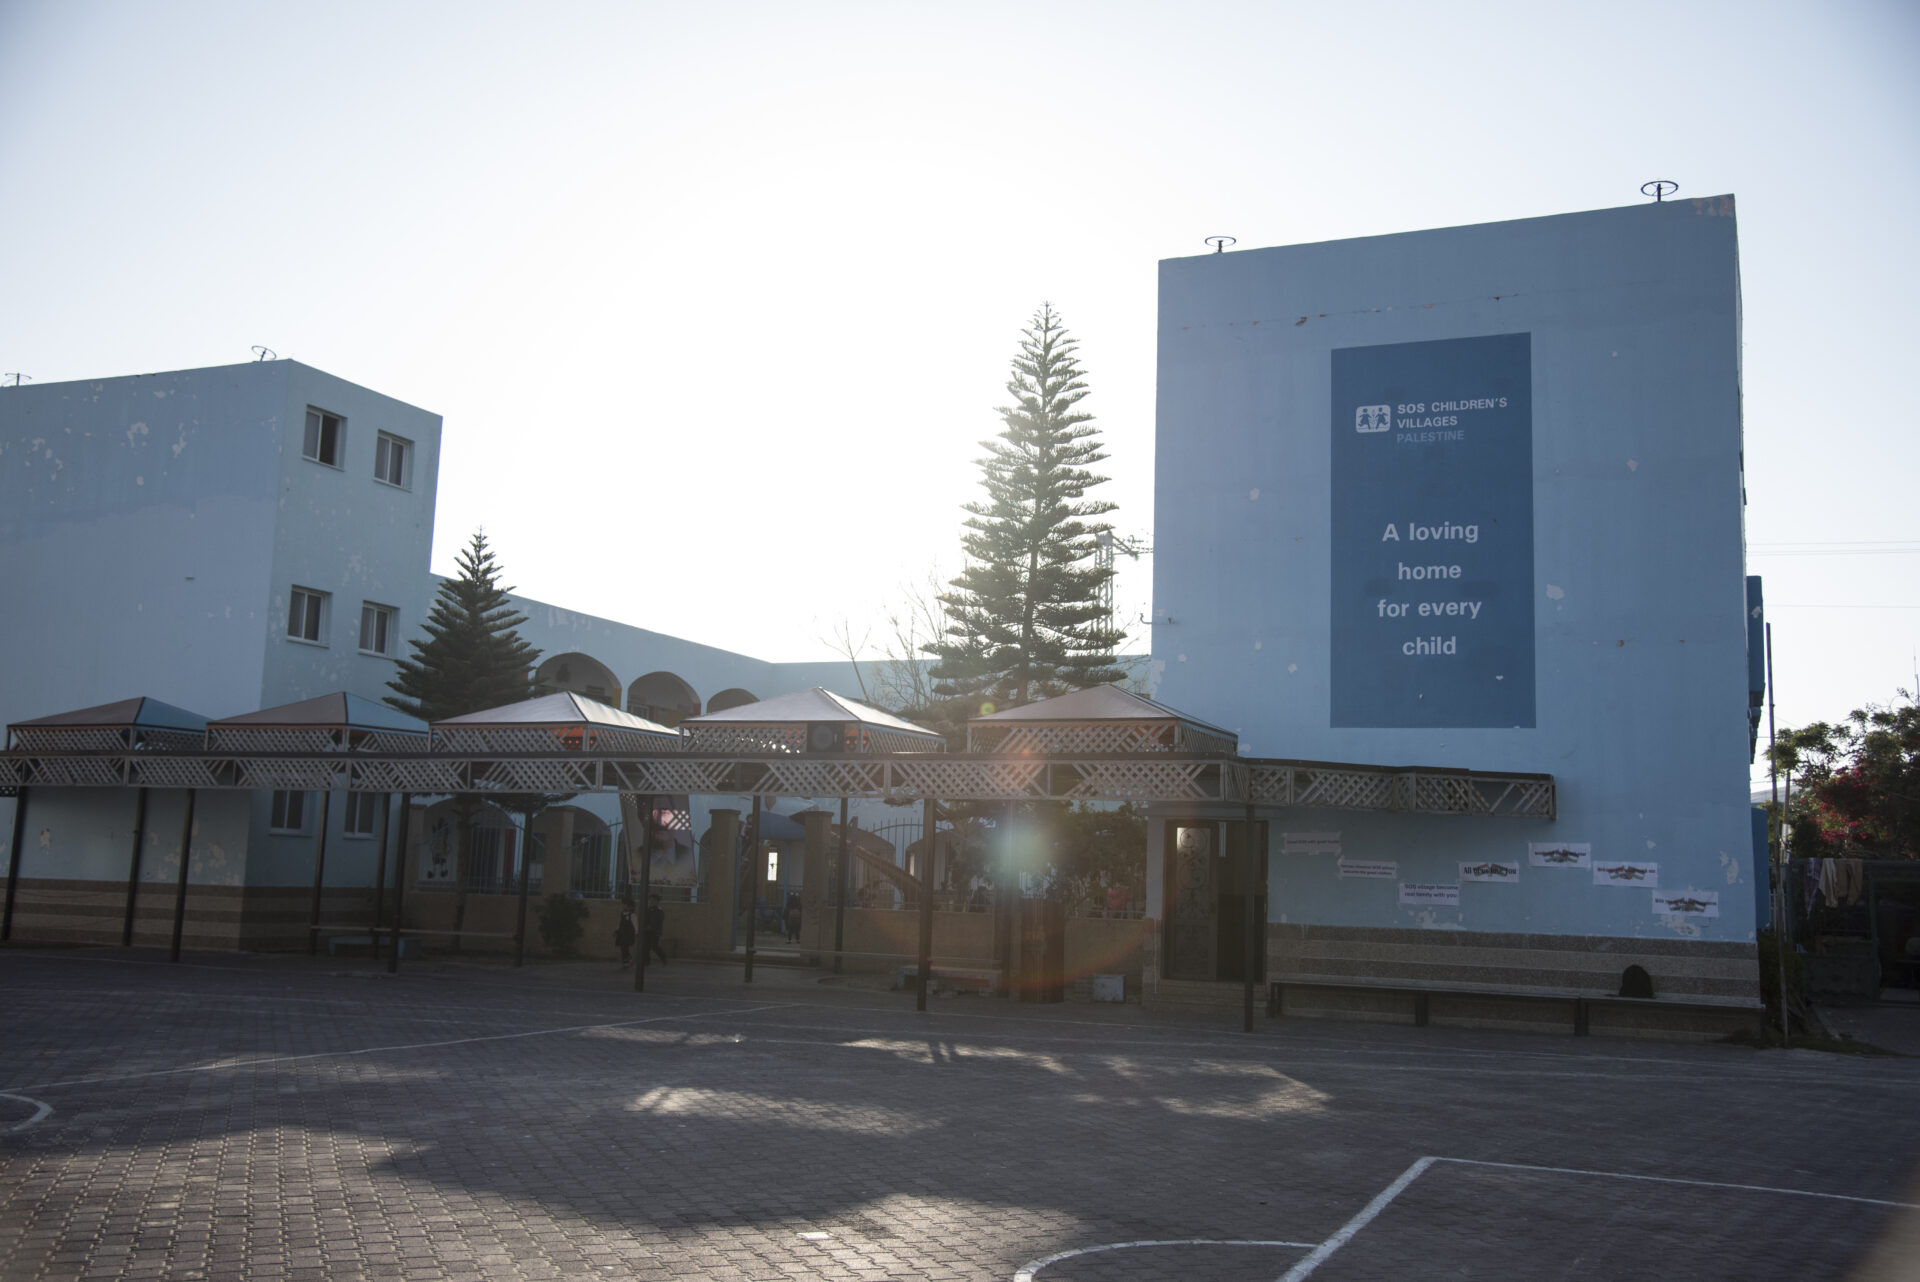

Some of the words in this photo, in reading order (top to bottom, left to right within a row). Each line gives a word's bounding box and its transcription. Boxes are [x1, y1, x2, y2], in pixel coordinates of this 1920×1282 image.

[1397, 403, 1425, 414] SOS
[1431, 397, 1508, 413] CHILDREN'S
[1397, 416, 1458, 429] VILLAGES
[1396, 430, 1465, 444] PALESTINE
[1382, 523, 1400, 542] A
[1409, 521, 1479, 543] loving
[1398, 562, 1462, 581] home
[1377, 599, 1410, 618] for
[1418, 600, 1482, 619] every
[1402, 636, 1457, 655] child
[1463, 866, 1472, 874] All
